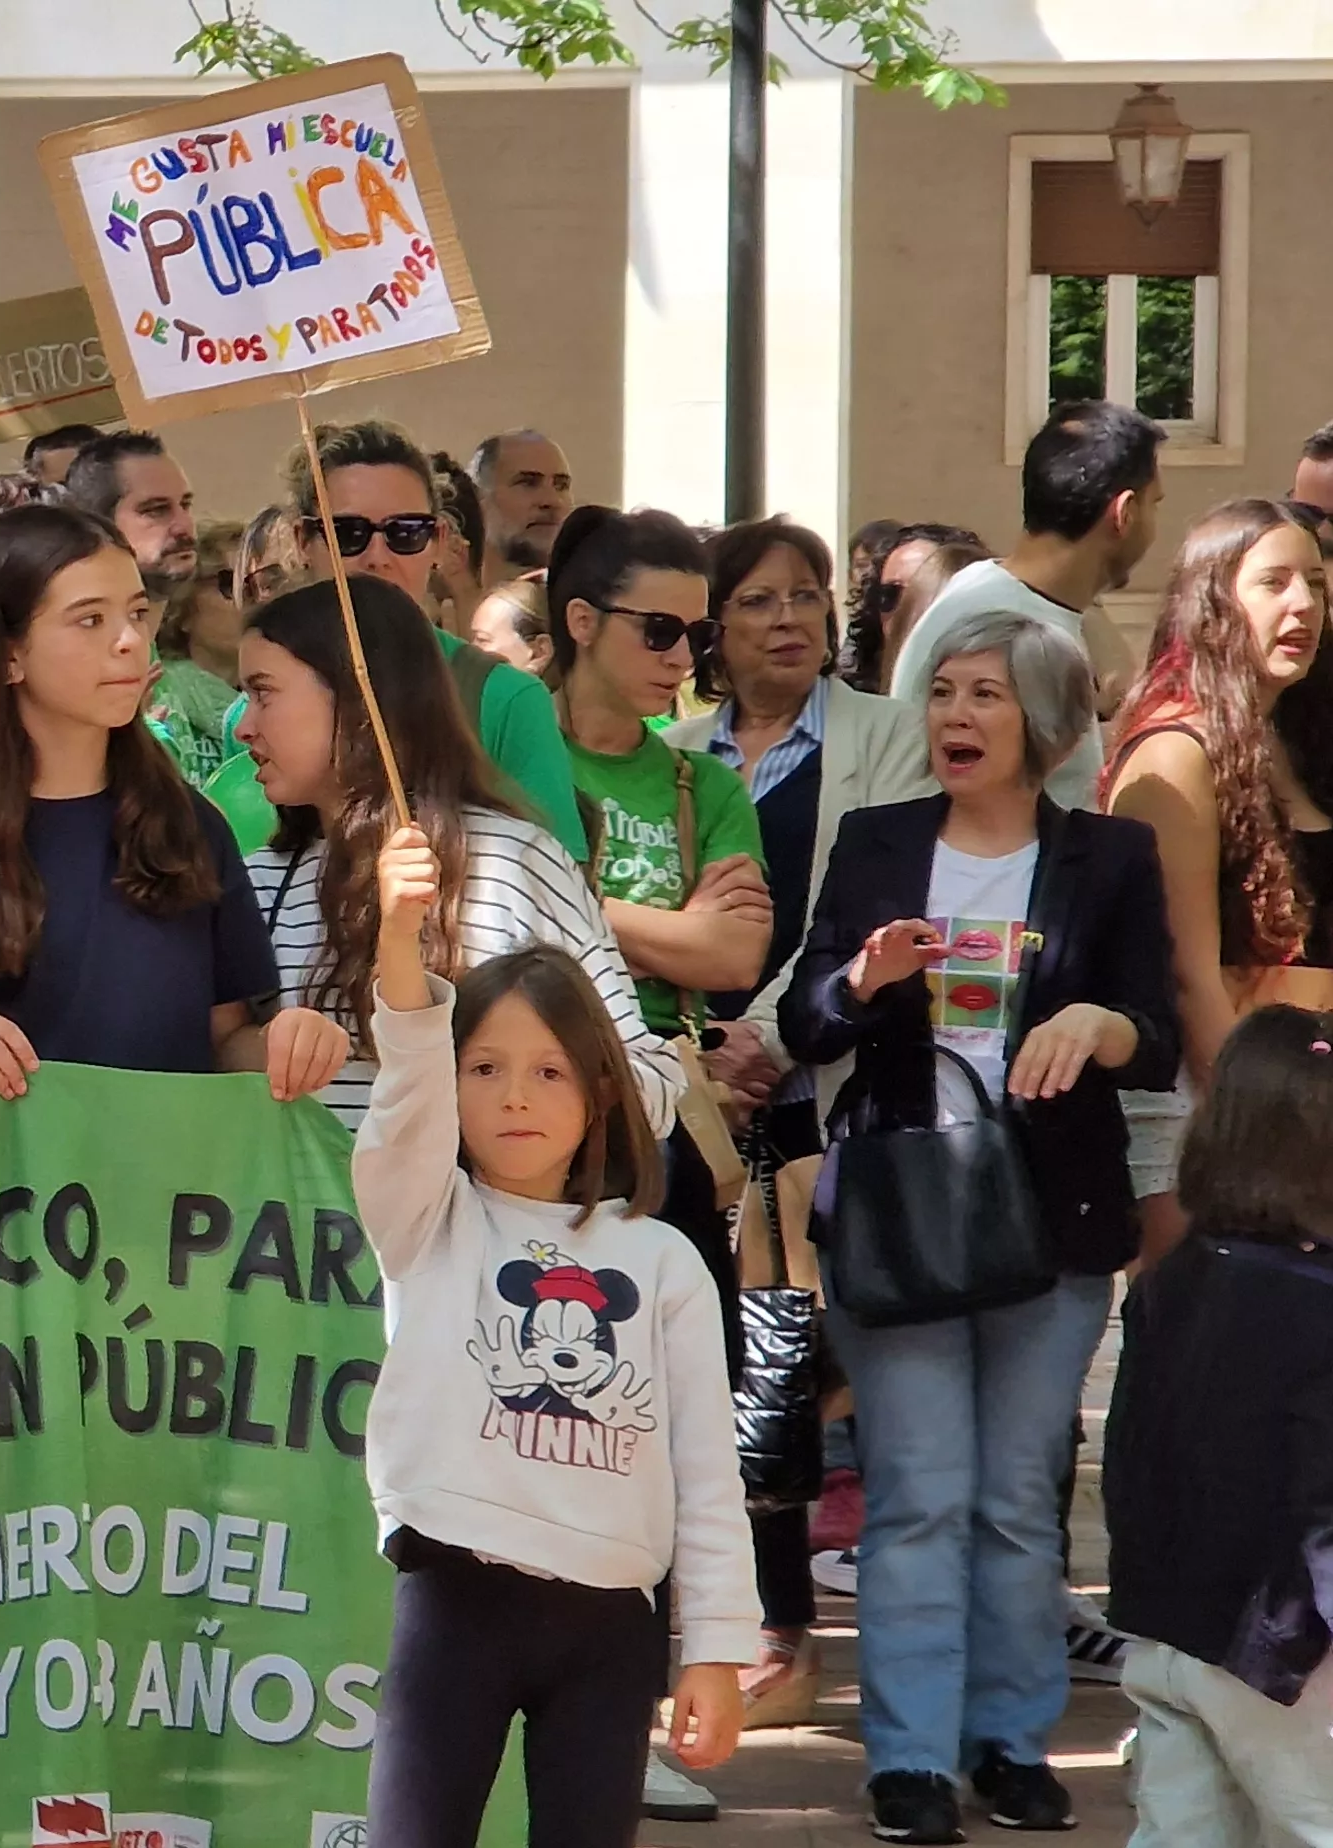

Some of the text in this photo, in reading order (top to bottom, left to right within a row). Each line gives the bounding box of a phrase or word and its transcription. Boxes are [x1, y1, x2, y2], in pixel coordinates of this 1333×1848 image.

[105, 190, 139, 252] ME
[129, 128, 253, 194] GUSTA
[301, 112, 410, 183] ESCUELA
[134, 236, 438, 365] DE TODOS Y PARA TODOS
[480, 1399, 638, 1477] MINNIE
[160, 1507, 312, 1614] DEL
[125, 1614, 385, 1752] AÑOS
